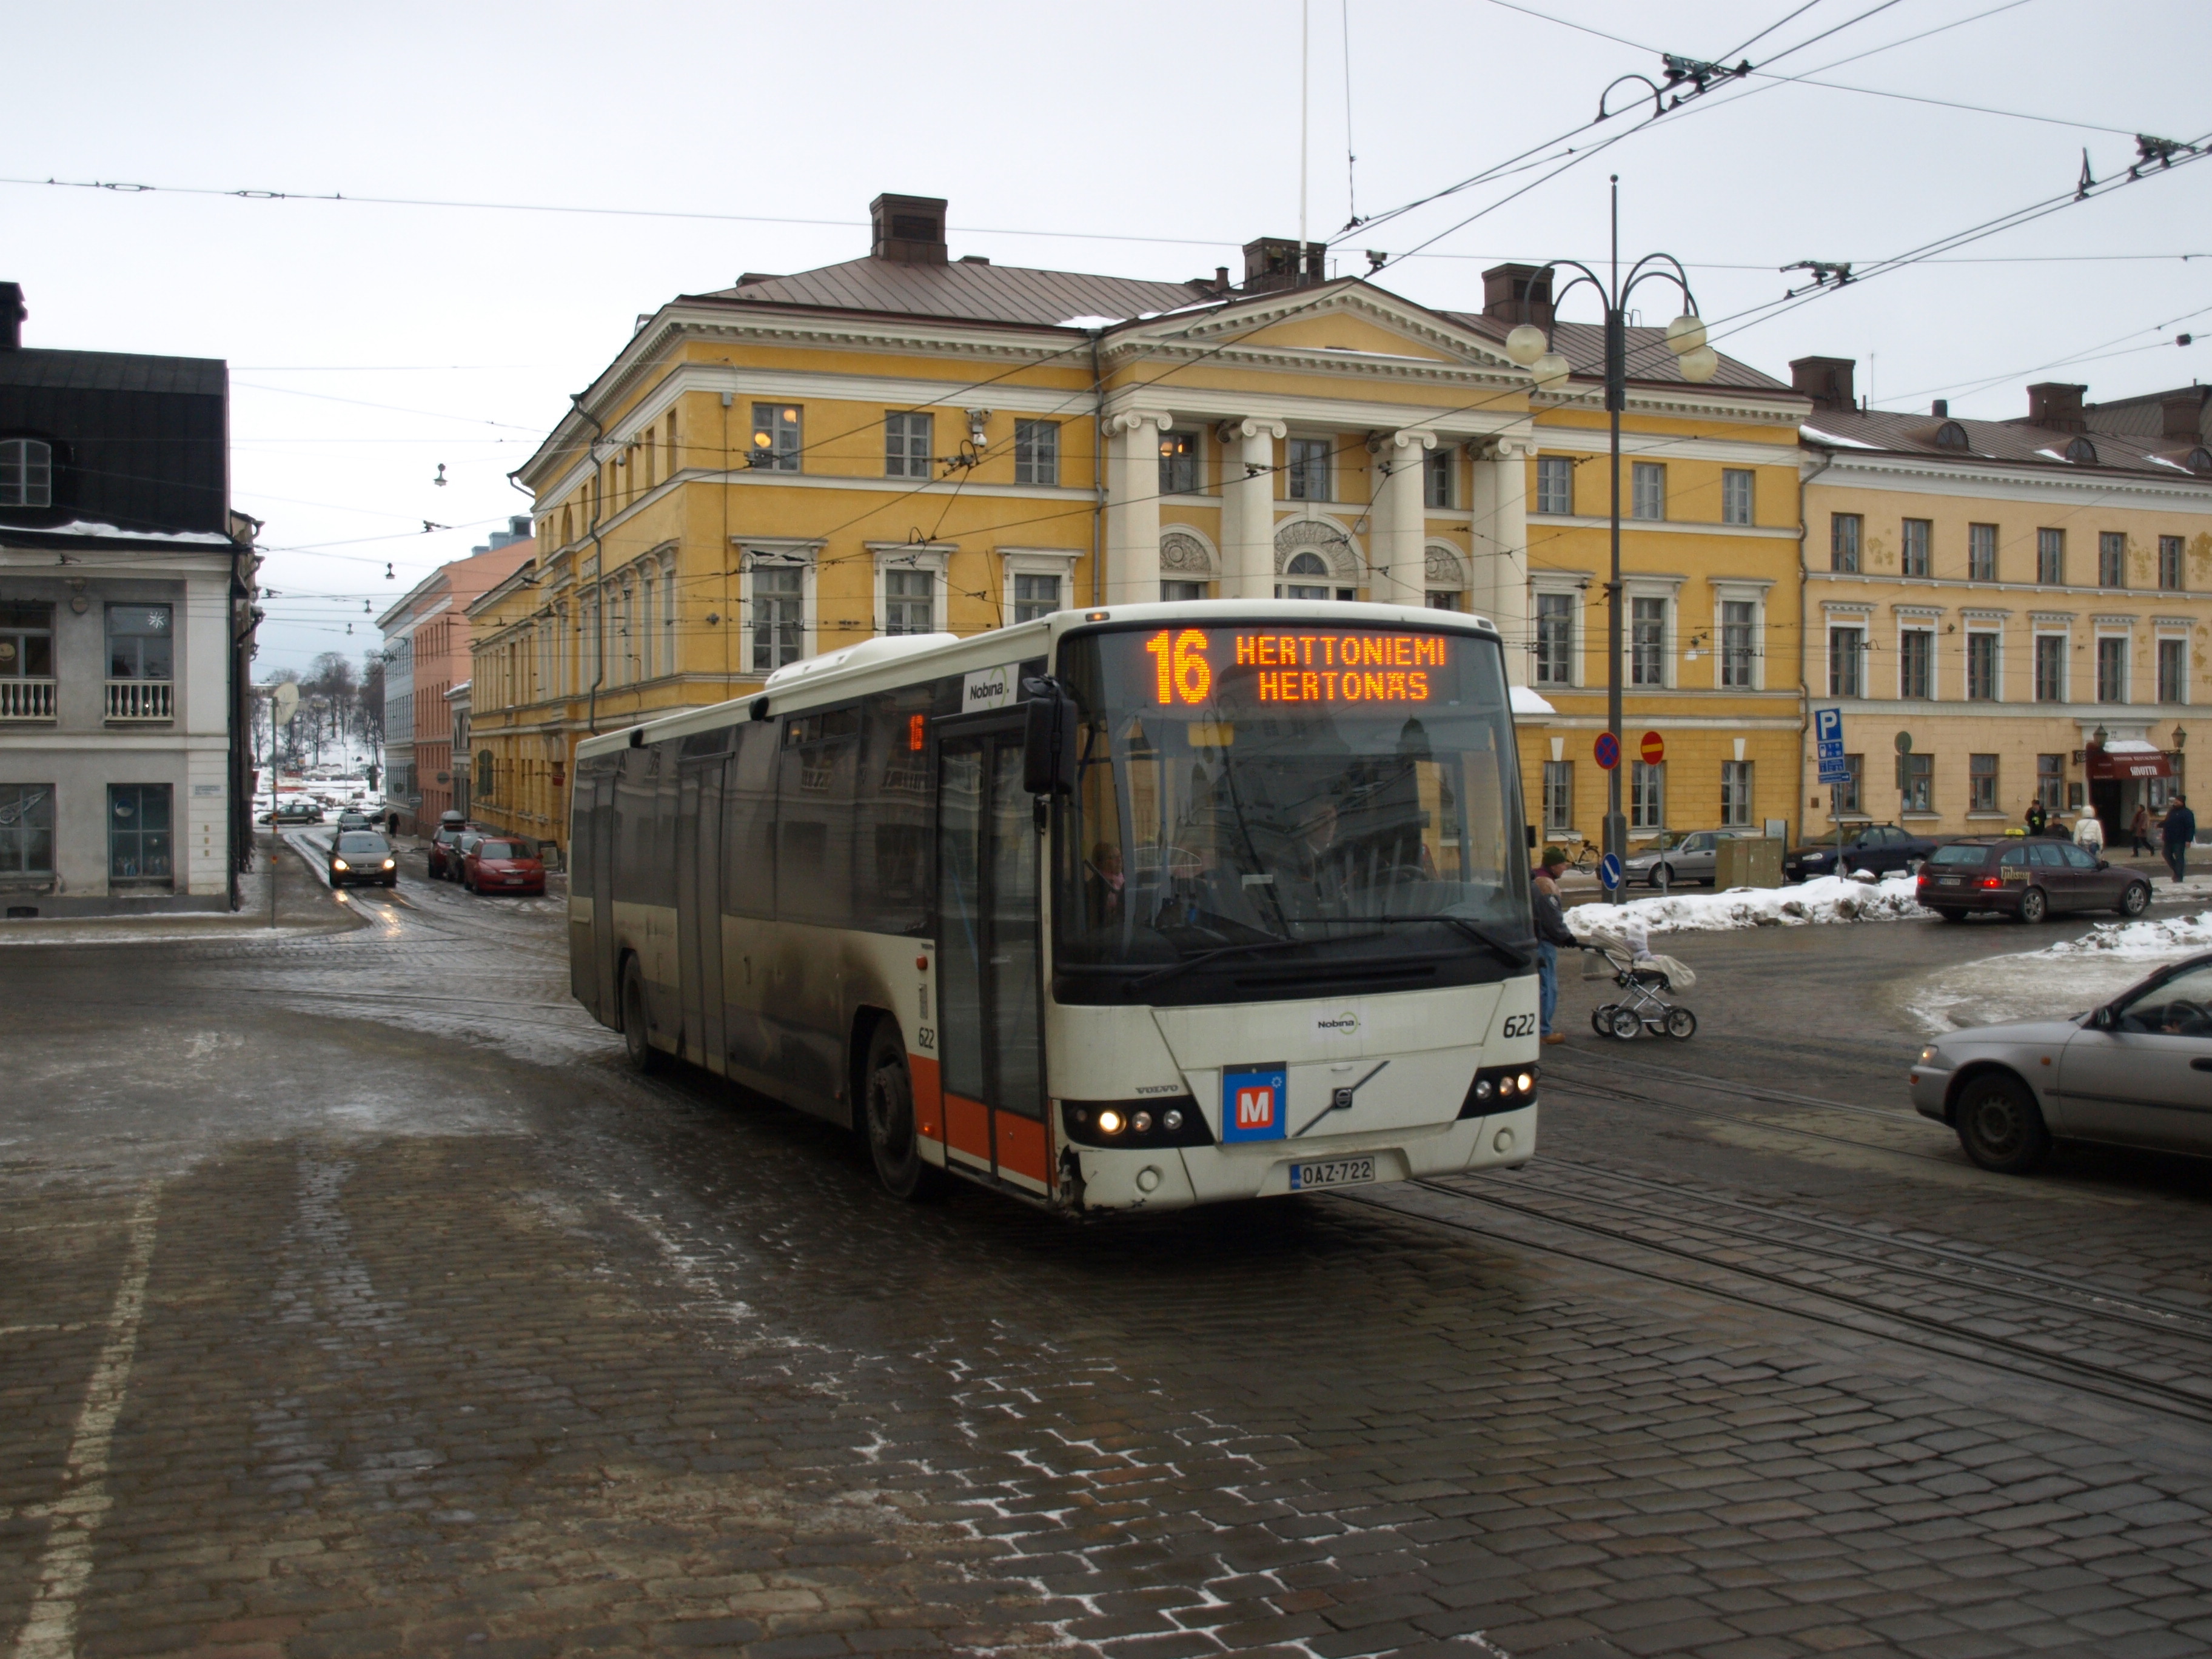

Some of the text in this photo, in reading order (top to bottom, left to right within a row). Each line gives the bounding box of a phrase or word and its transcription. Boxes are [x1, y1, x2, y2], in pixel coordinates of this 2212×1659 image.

[1236, 635, 1446, 666] HERTTONIEMI
[1146, 628, 1212, 705] 16
[1259, 672, 1429, 701] HERTONÄS
[910, 714, 924, 751] 16
[1820, 711, 1837, 740] P
[2130, 765, 2157, 776] SAVOTTA
[2000, 866, 2032, 886] Gibson
[919, 1027, 934, 1050] 622
[1503, 1012, 1535, 1039] 622
[1135, 1084, 1179, 1094] VOLVO
[1240, 1091, 1269, 1124] M
